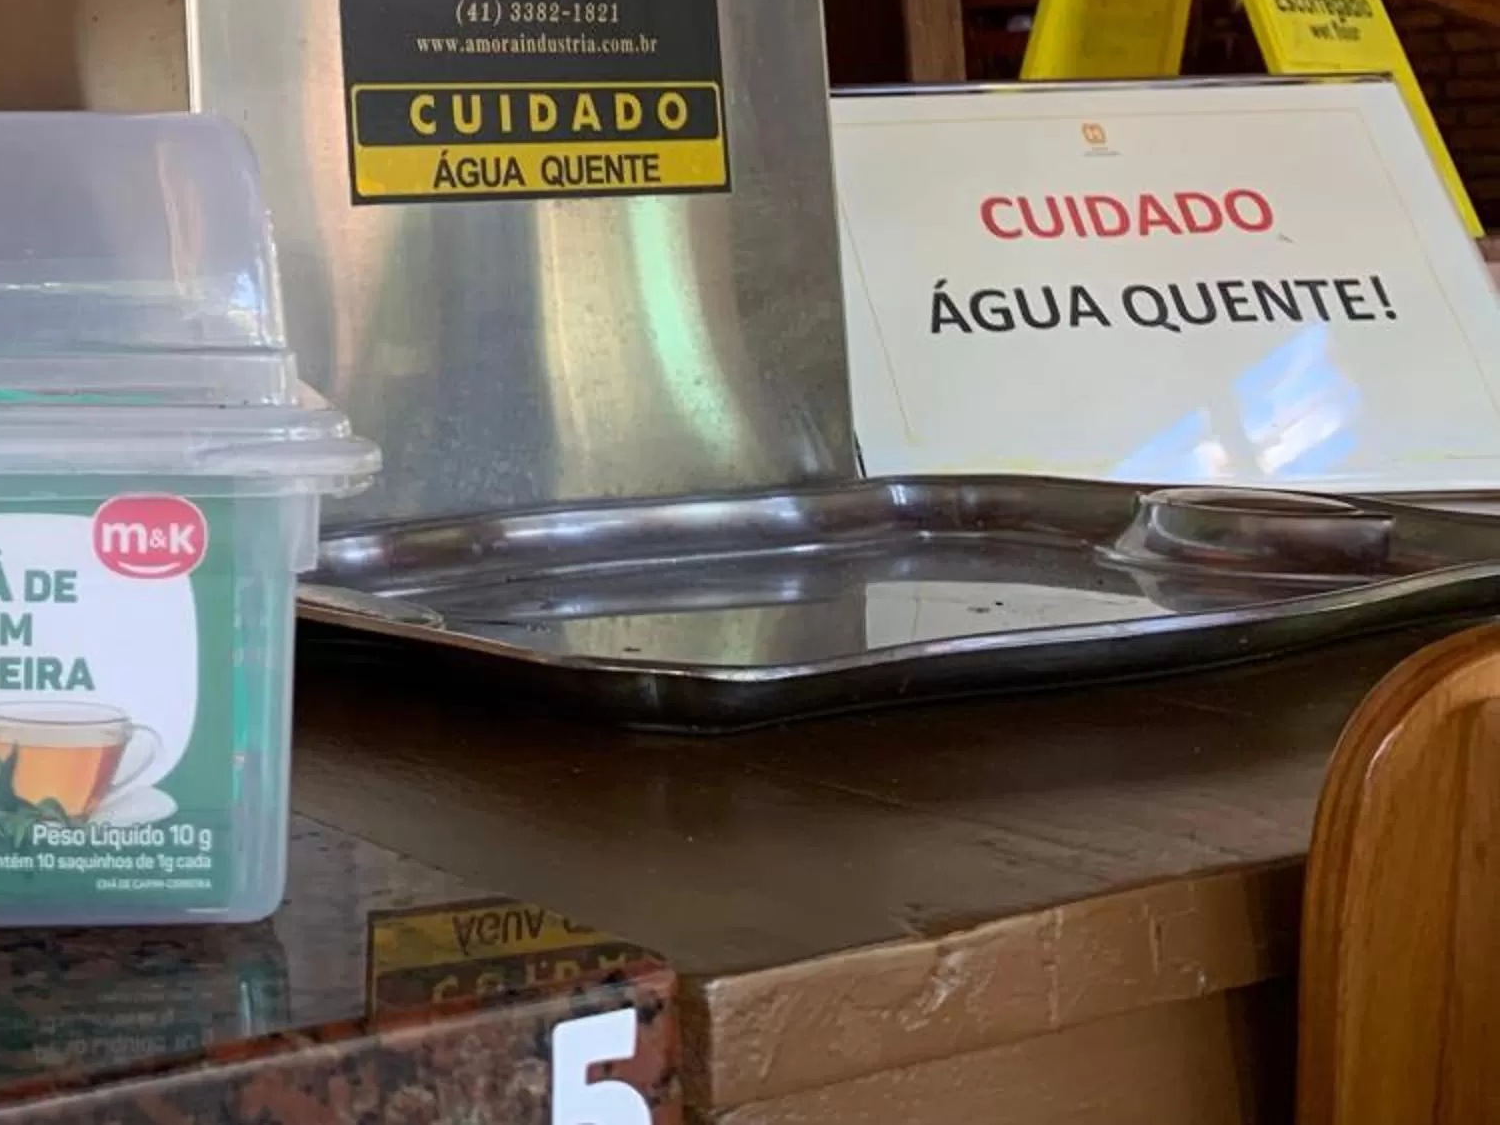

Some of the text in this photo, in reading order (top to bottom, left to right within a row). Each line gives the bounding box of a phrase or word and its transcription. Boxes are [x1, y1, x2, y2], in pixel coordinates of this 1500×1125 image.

[455, 0, 619, 26] (41) 3382-1821
[416, 33, 660, 56] www.amoraindustria.com.br
[409, 92, 689, 136] CUIDADO
[433, 150, 661, 190] ÁGUA QUENTE
[980, 188, 1274, 240] CUIDADO
[930, 275, 1397, 334] ÁGUA QUENTE!
[24, 569, 78, 604] DE
[32, 825, 86, 847] Peso
[169, 824, 193, 846] 10
[198, 827, 212, 851] g
[37, 853, 54, 869] 10
[136, 852, 154, 868] de
[175, 853, 212, 869] cada
